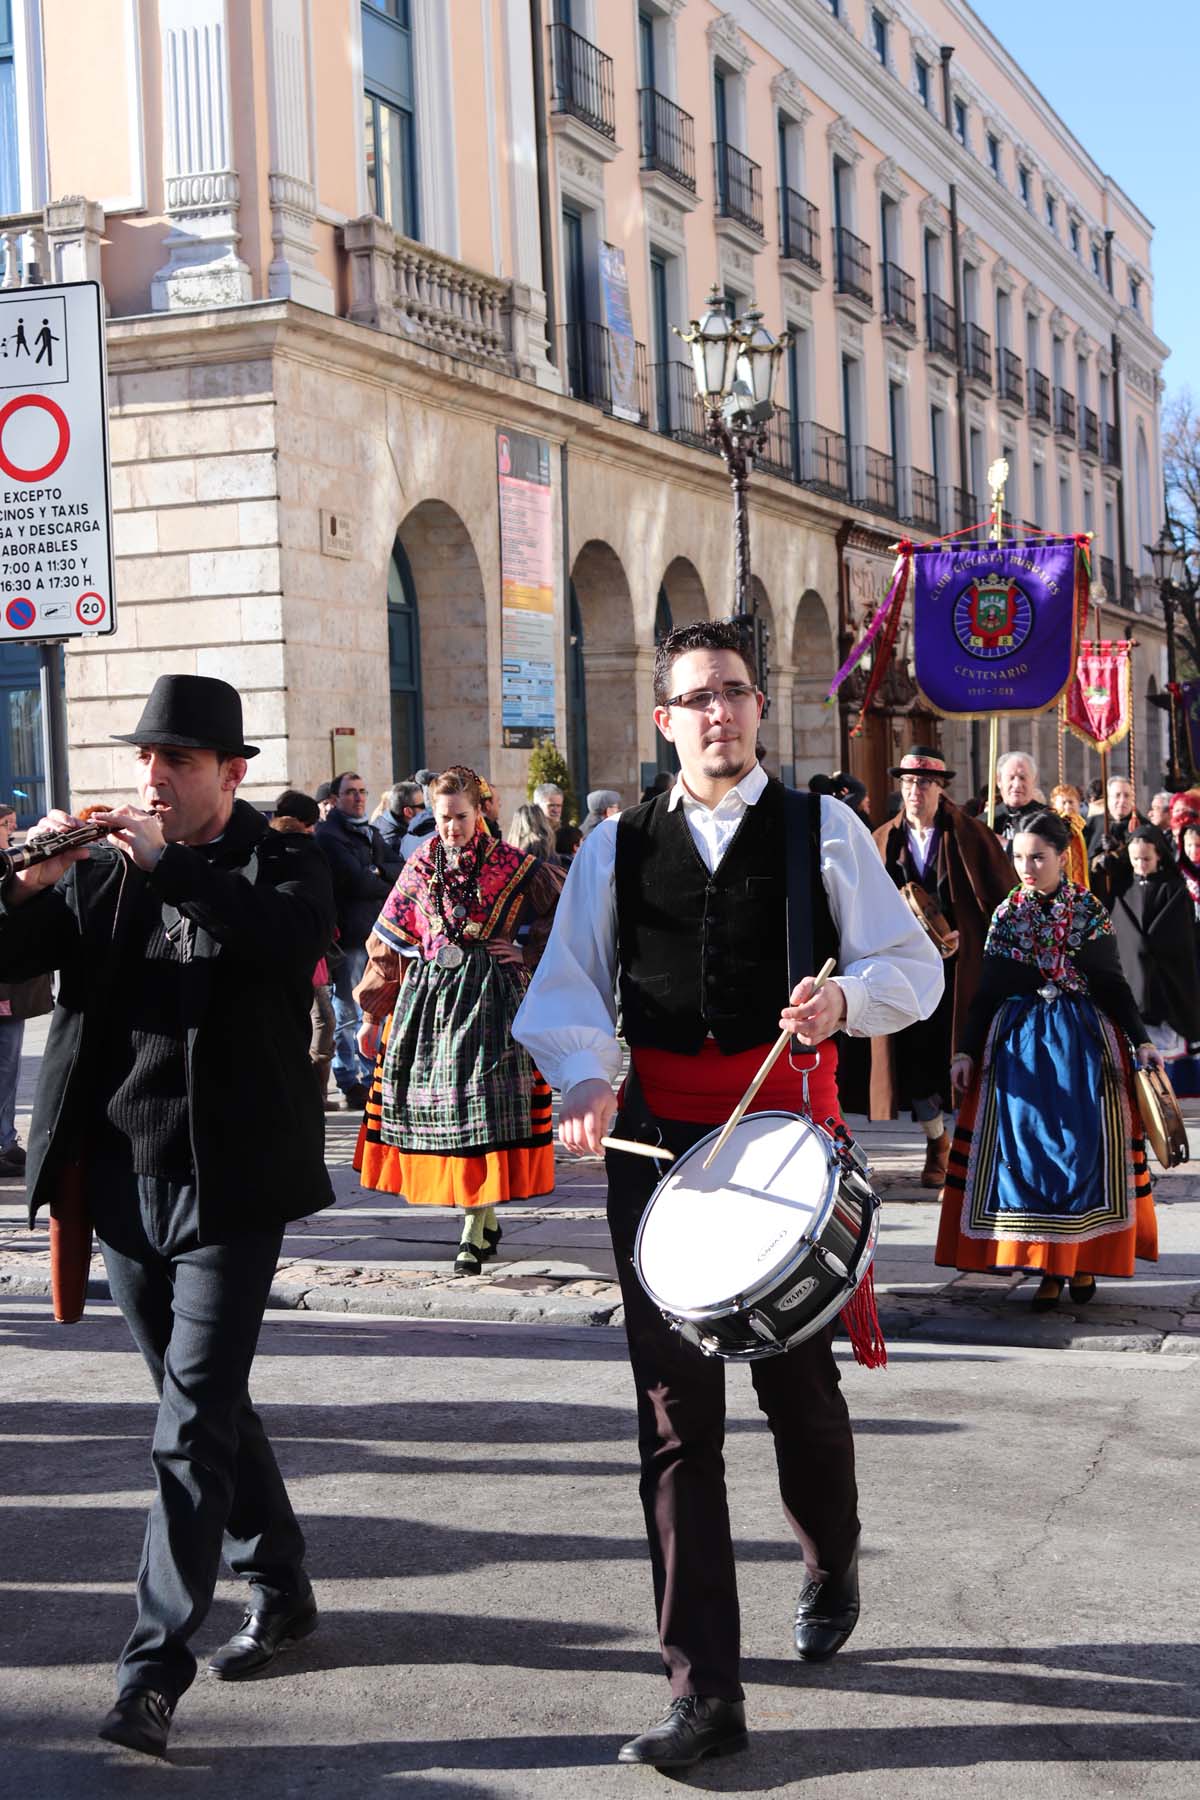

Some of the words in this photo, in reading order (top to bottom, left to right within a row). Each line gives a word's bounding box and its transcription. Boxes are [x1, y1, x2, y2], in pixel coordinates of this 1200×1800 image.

[4, 488, 62, 504] EXCEPTO
[39, 507, 46, 518] Y
[52, 503, 89, 517] TAXIS
[18, 526, 25, 537] Y
[30, 520, 100, 536] DESCARGA
[2, 562, 30, 575] 7:00
[35, 561, 43, 572] A
[47, 558, 76, 571] 11:30
[81, 557, 88, 569] Y
[0, 579, 31, 592] 16:30
[36, 577, 45, 590] A
[49, 576, 79, 589] 17:30
[84, 574, 95, 586] H.
[930, 573, 952, 601] CLUB
[953, 553, 1004, 574] CICLISTA
[82, 603, 100, 614] 20
[953, 663, 1029, 680] CENTENARIO
